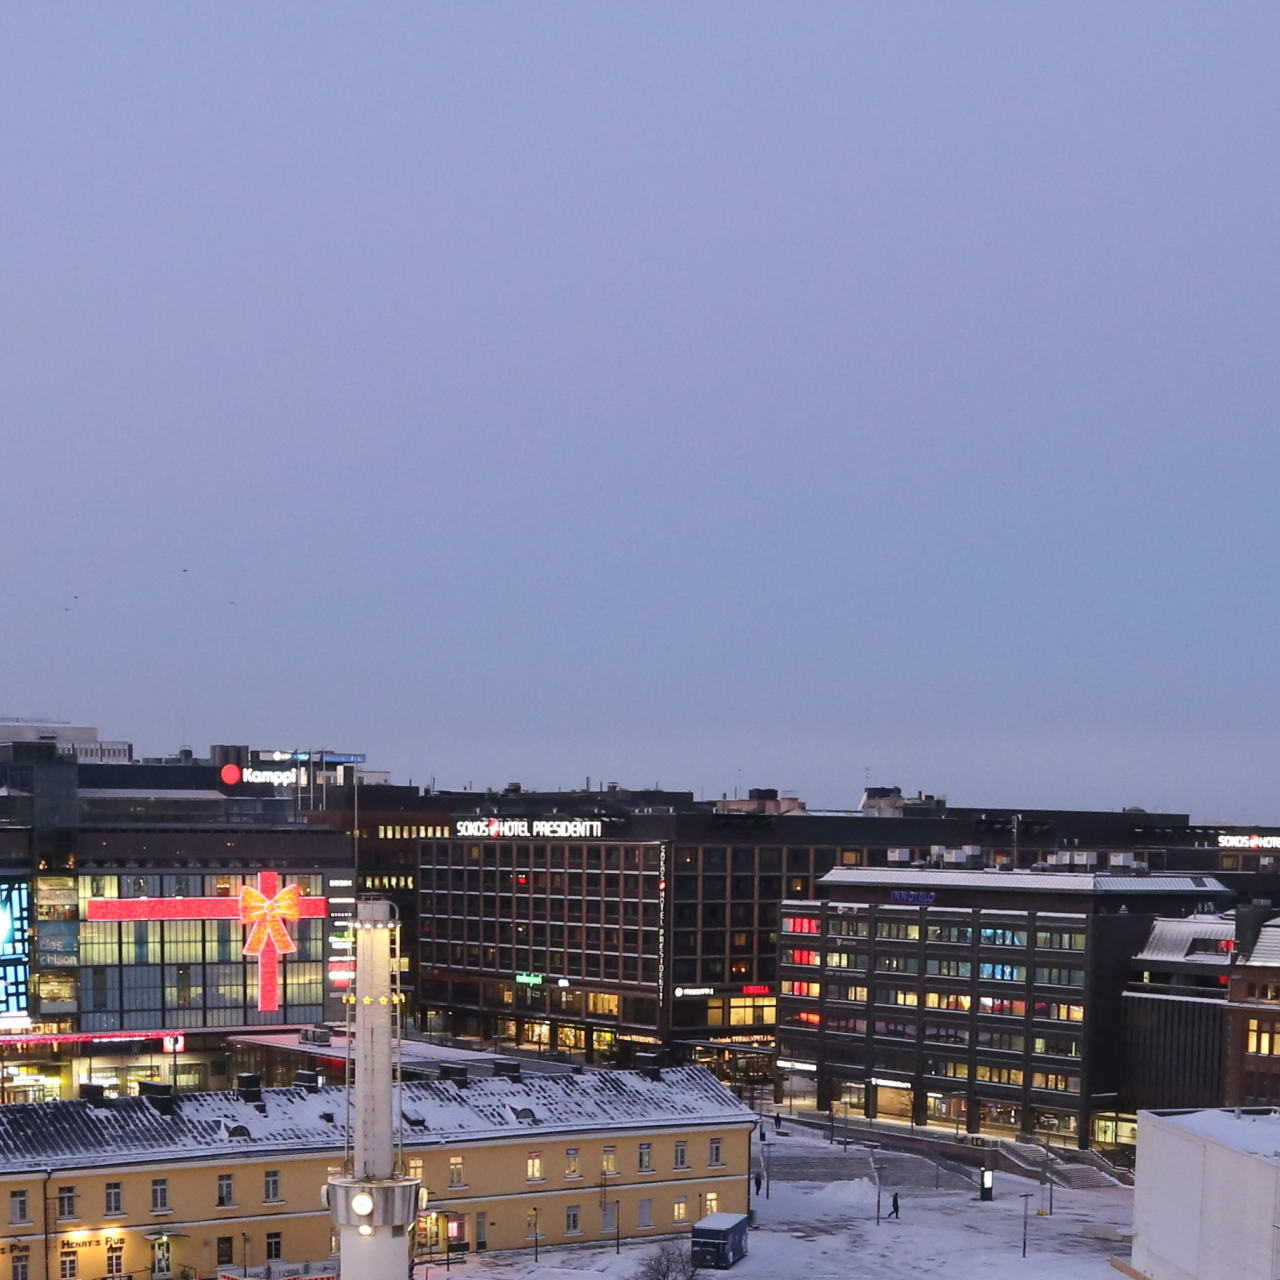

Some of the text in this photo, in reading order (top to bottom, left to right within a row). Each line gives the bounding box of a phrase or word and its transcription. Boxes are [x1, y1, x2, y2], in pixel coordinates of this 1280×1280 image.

[242, 768, 297, 787] Kamppi
[456, 821, 601, 837] SOKOS HOTEL PRESIDENTTI
[1218, 836, 1249, 847] SOKOS
[105, 1237, 124, 1246] PUB
[10, 1244, 29, 1253] PUB
